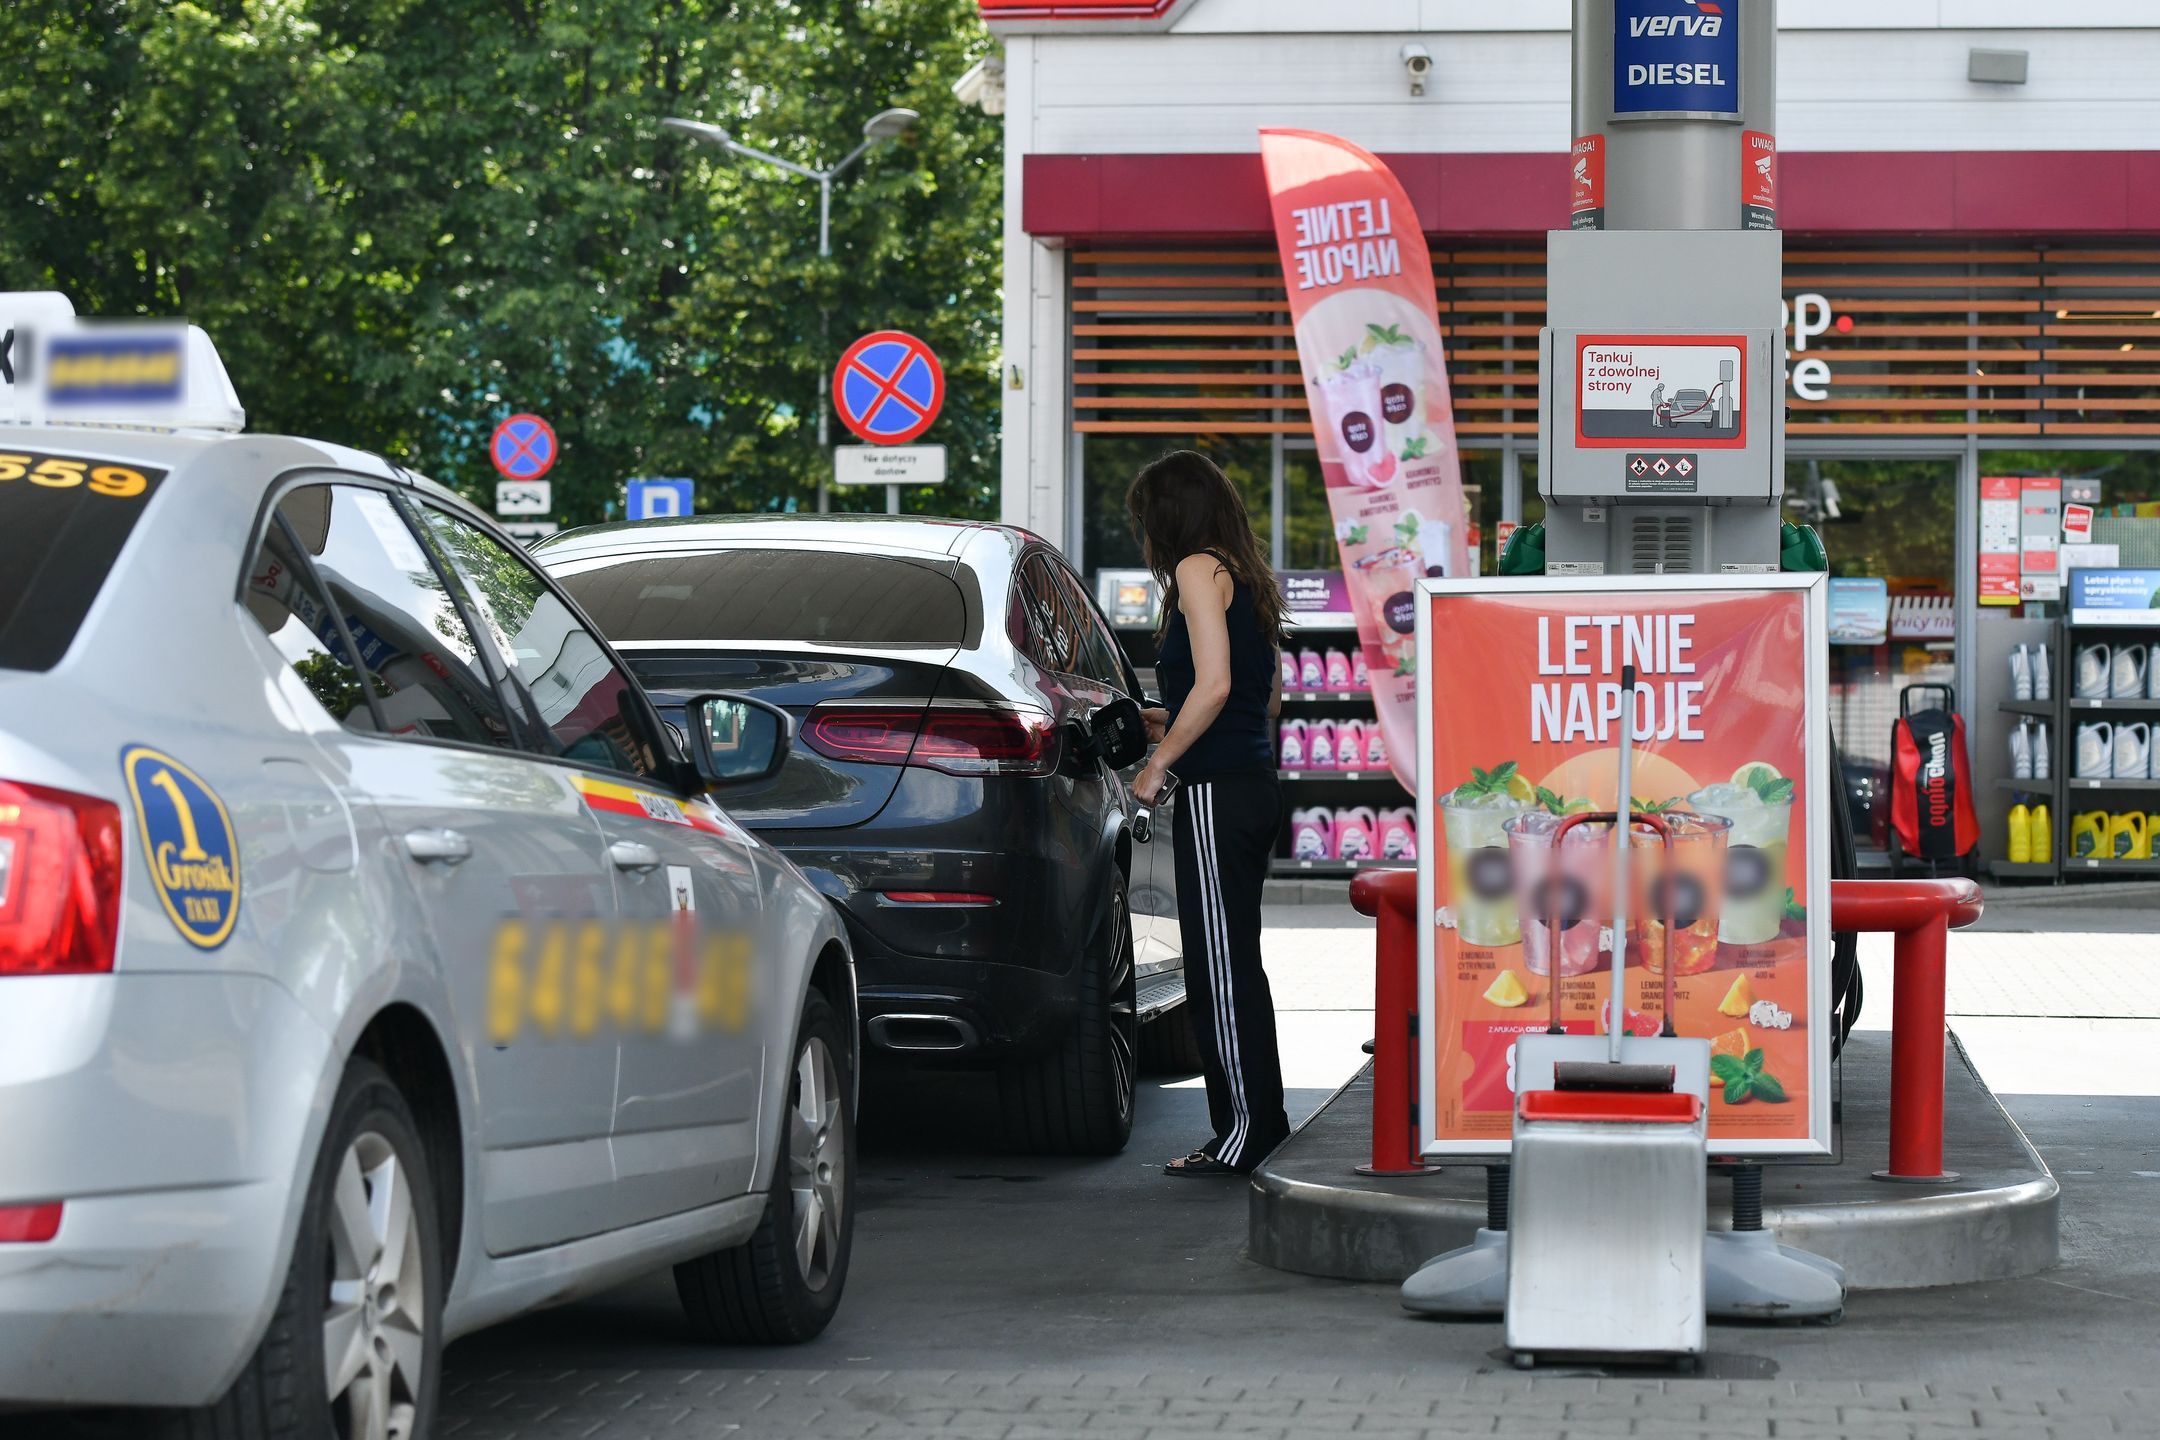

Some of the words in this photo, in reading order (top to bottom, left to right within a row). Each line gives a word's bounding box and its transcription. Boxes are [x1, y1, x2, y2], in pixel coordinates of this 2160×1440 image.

[1629, 15, 1722, 37] verva
[1628, 63, 1726, 86] DIESEL
[1588, 351, 1633, 366] Tankuj
[1588, 367, 1596, 377] z
[1598, 366, 1660, 380] dowolnej
[1588, 380, 1633, 394] strony
[1538, 614, 1697, 676] LETNIE
[1531, 681, 1704, 742] NAPOJE
[1922, 731, 1949, 827] ogniochron
[151, 768, 208, 861] 1
